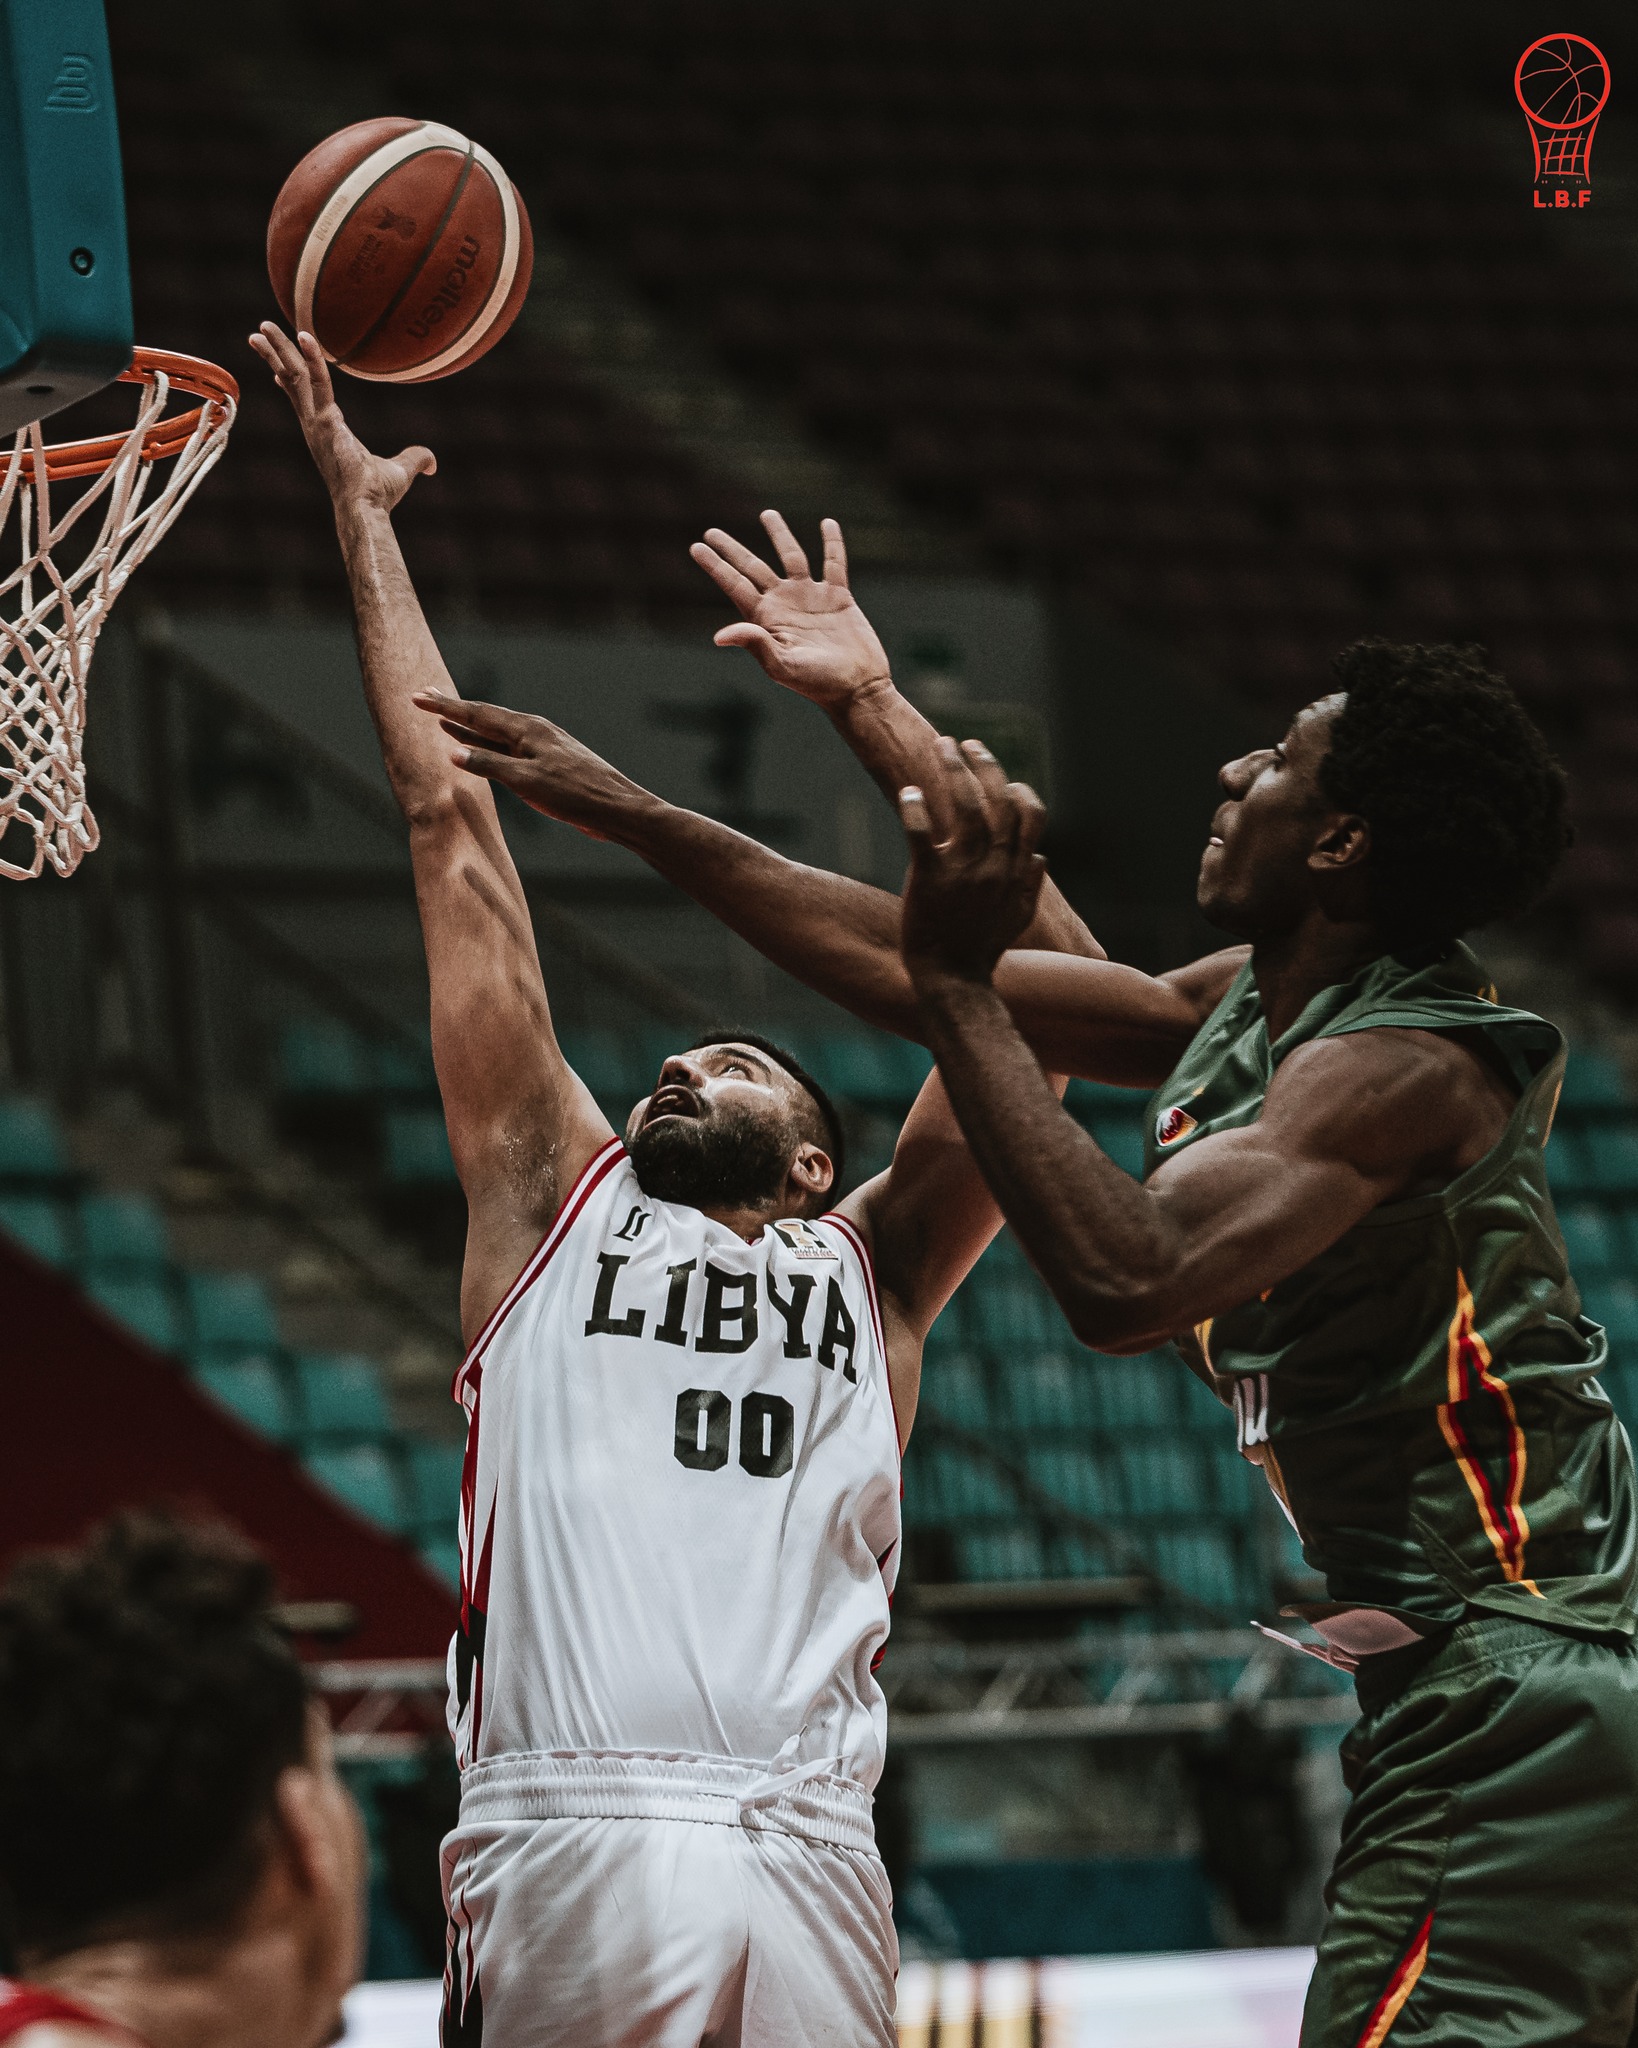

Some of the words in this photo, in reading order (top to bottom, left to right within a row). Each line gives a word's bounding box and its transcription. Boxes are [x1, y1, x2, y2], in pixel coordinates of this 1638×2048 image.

[406, 234, 481, 339] molten
[584, 1251, 858, 1386] LIBYA
[673, 1388, 794, 1478] 00
